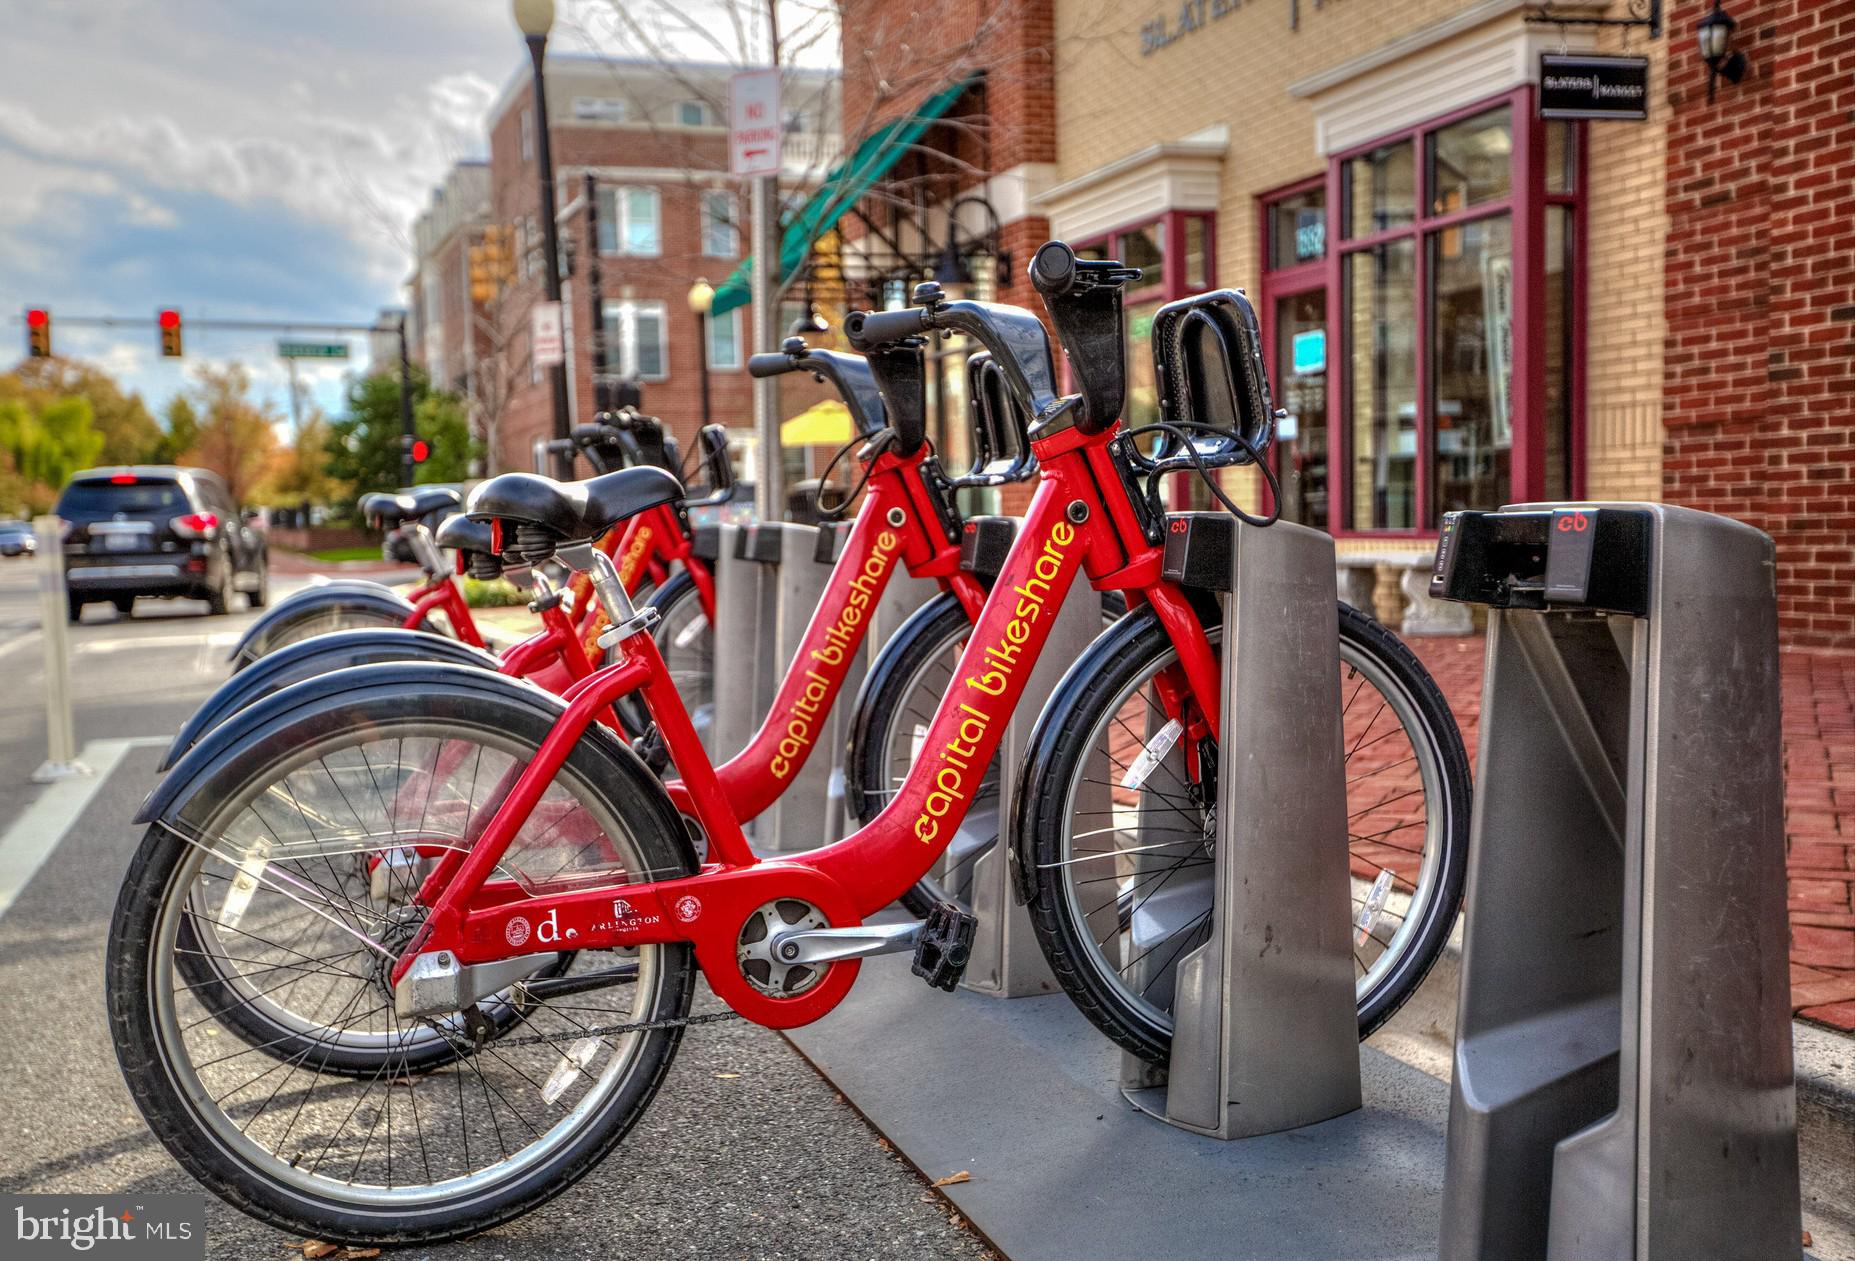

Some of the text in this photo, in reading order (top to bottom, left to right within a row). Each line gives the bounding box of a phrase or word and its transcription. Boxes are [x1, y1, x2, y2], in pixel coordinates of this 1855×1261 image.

[745, 102, 766, 120] NO
[1600, 85, 1643, 98] MARKET
[771, 531, 896, 778] capital bikeshare
[914, 521, 1075, 844] capital bikeshare
